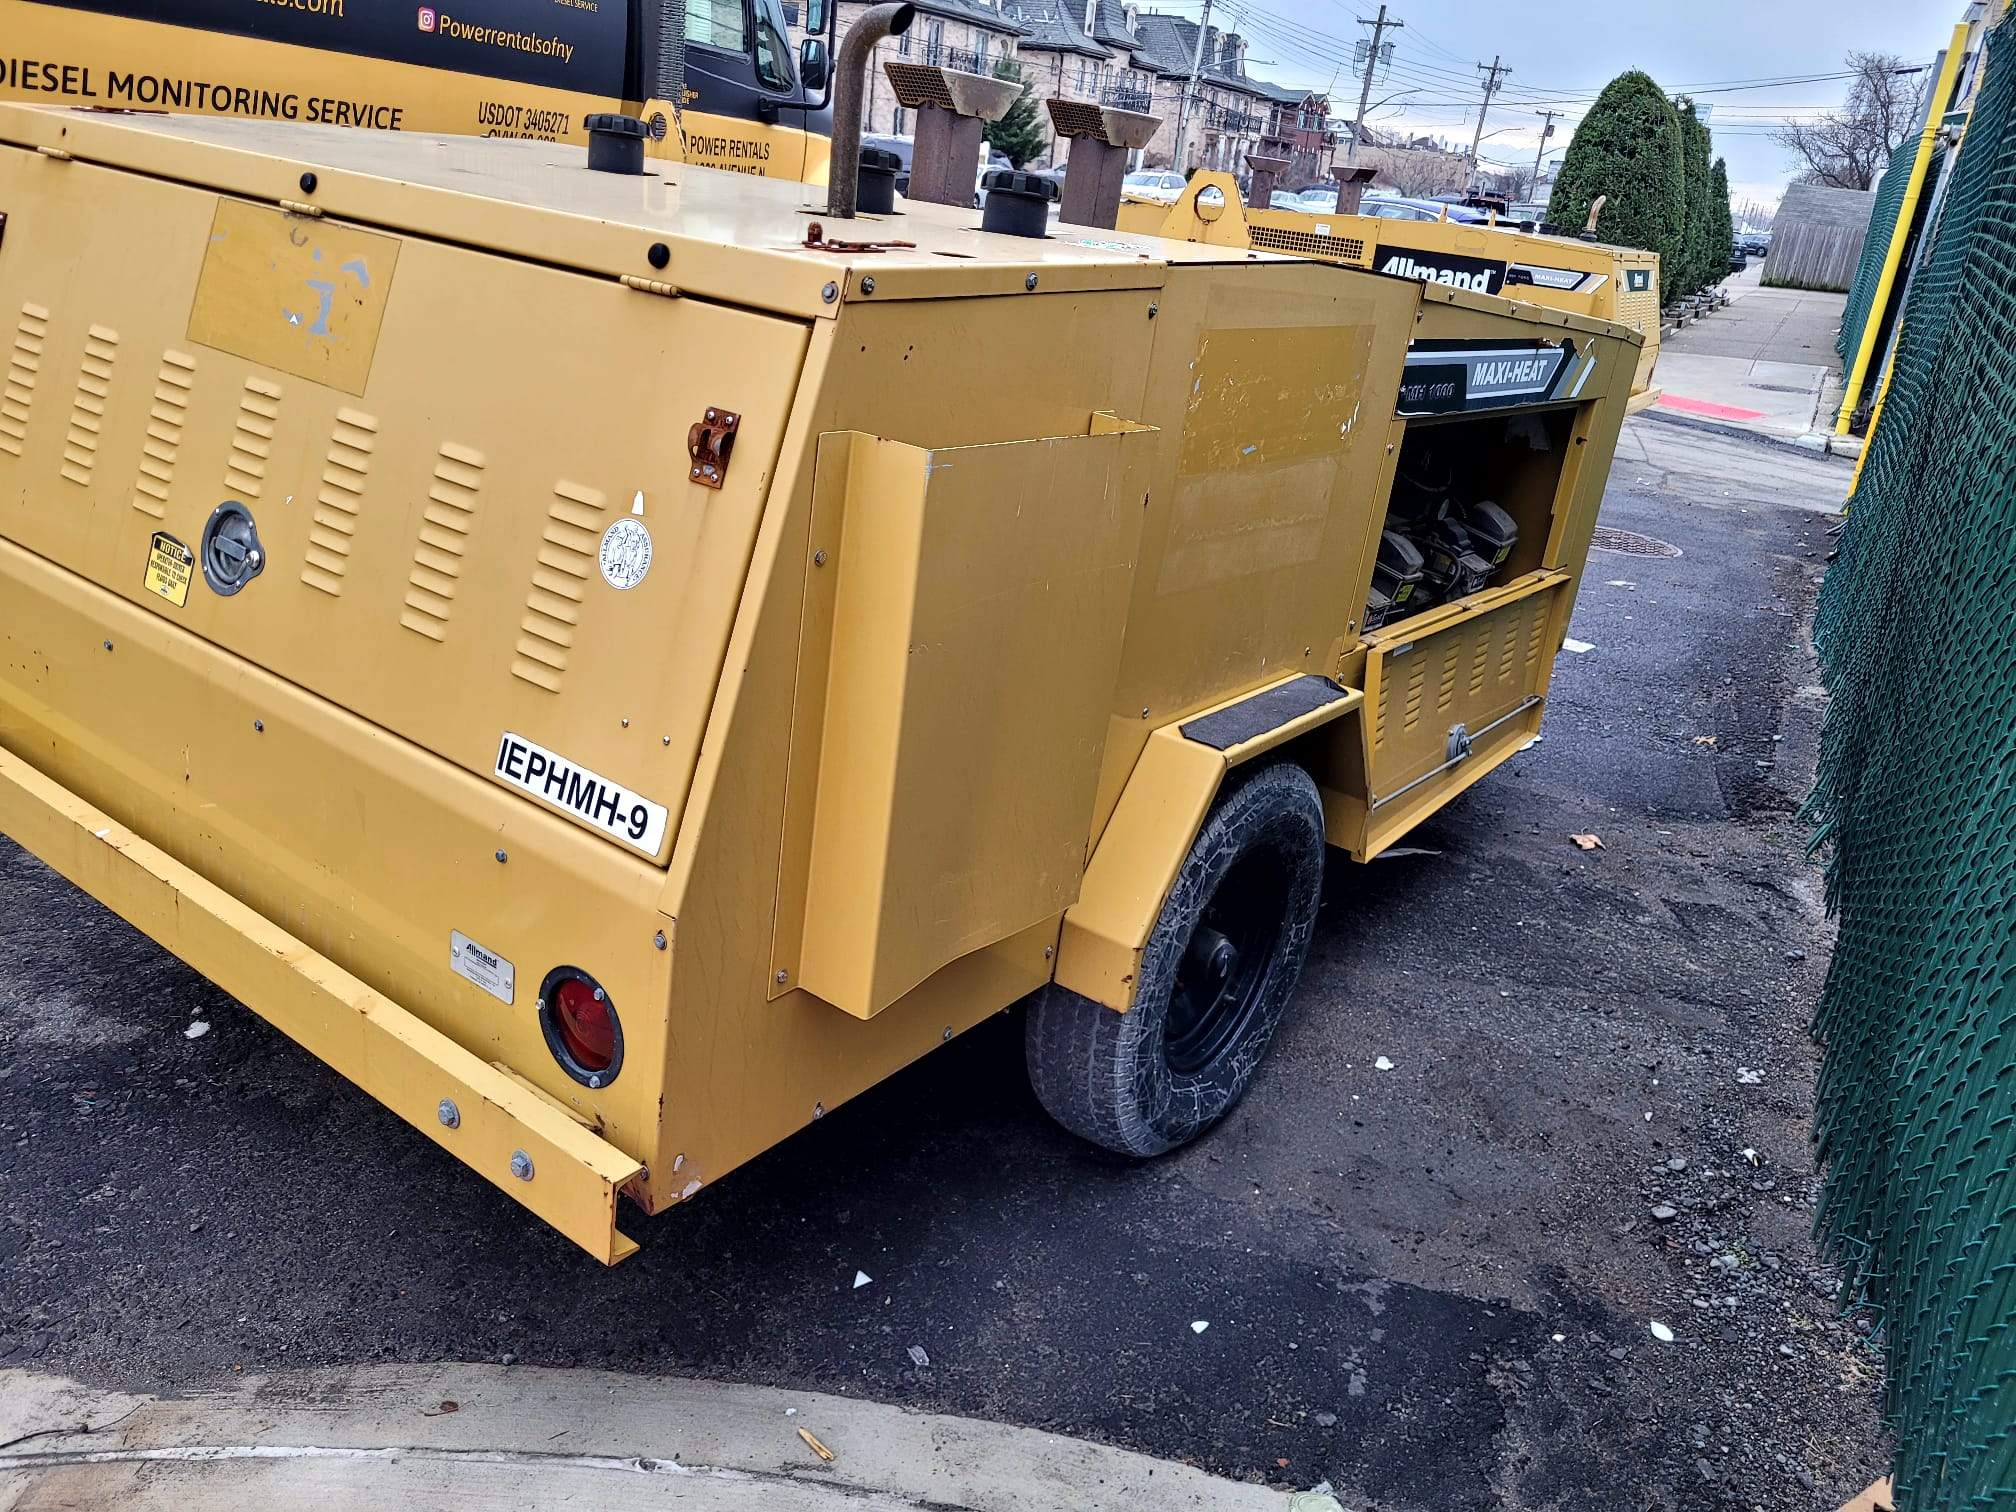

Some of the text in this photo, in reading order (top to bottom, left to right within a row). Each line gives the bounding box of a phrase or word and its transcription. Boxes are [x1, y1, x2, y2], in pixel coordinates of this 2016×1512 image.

[439, 15, 574, 63] Powerrentalsofny
[107, 71, 299, 120] MONITORING
[305, 97, 403, 131] SERVICE
[478, 101, 570, 135] USDOT 3405271
[690, 135, 770, 160] POWER RENTALS
[1380, 256, 1491, 294] Allmand
[1534, 274, 1574, 285] MAXI-HEAT
[1472, 359, 1548, 386] MAXI-HEAT
[160, 542, 186, 562] NOTICE
[497, 738, 649, 840] IEPHMH-9
[466, 943, 497, 966] Allmand
